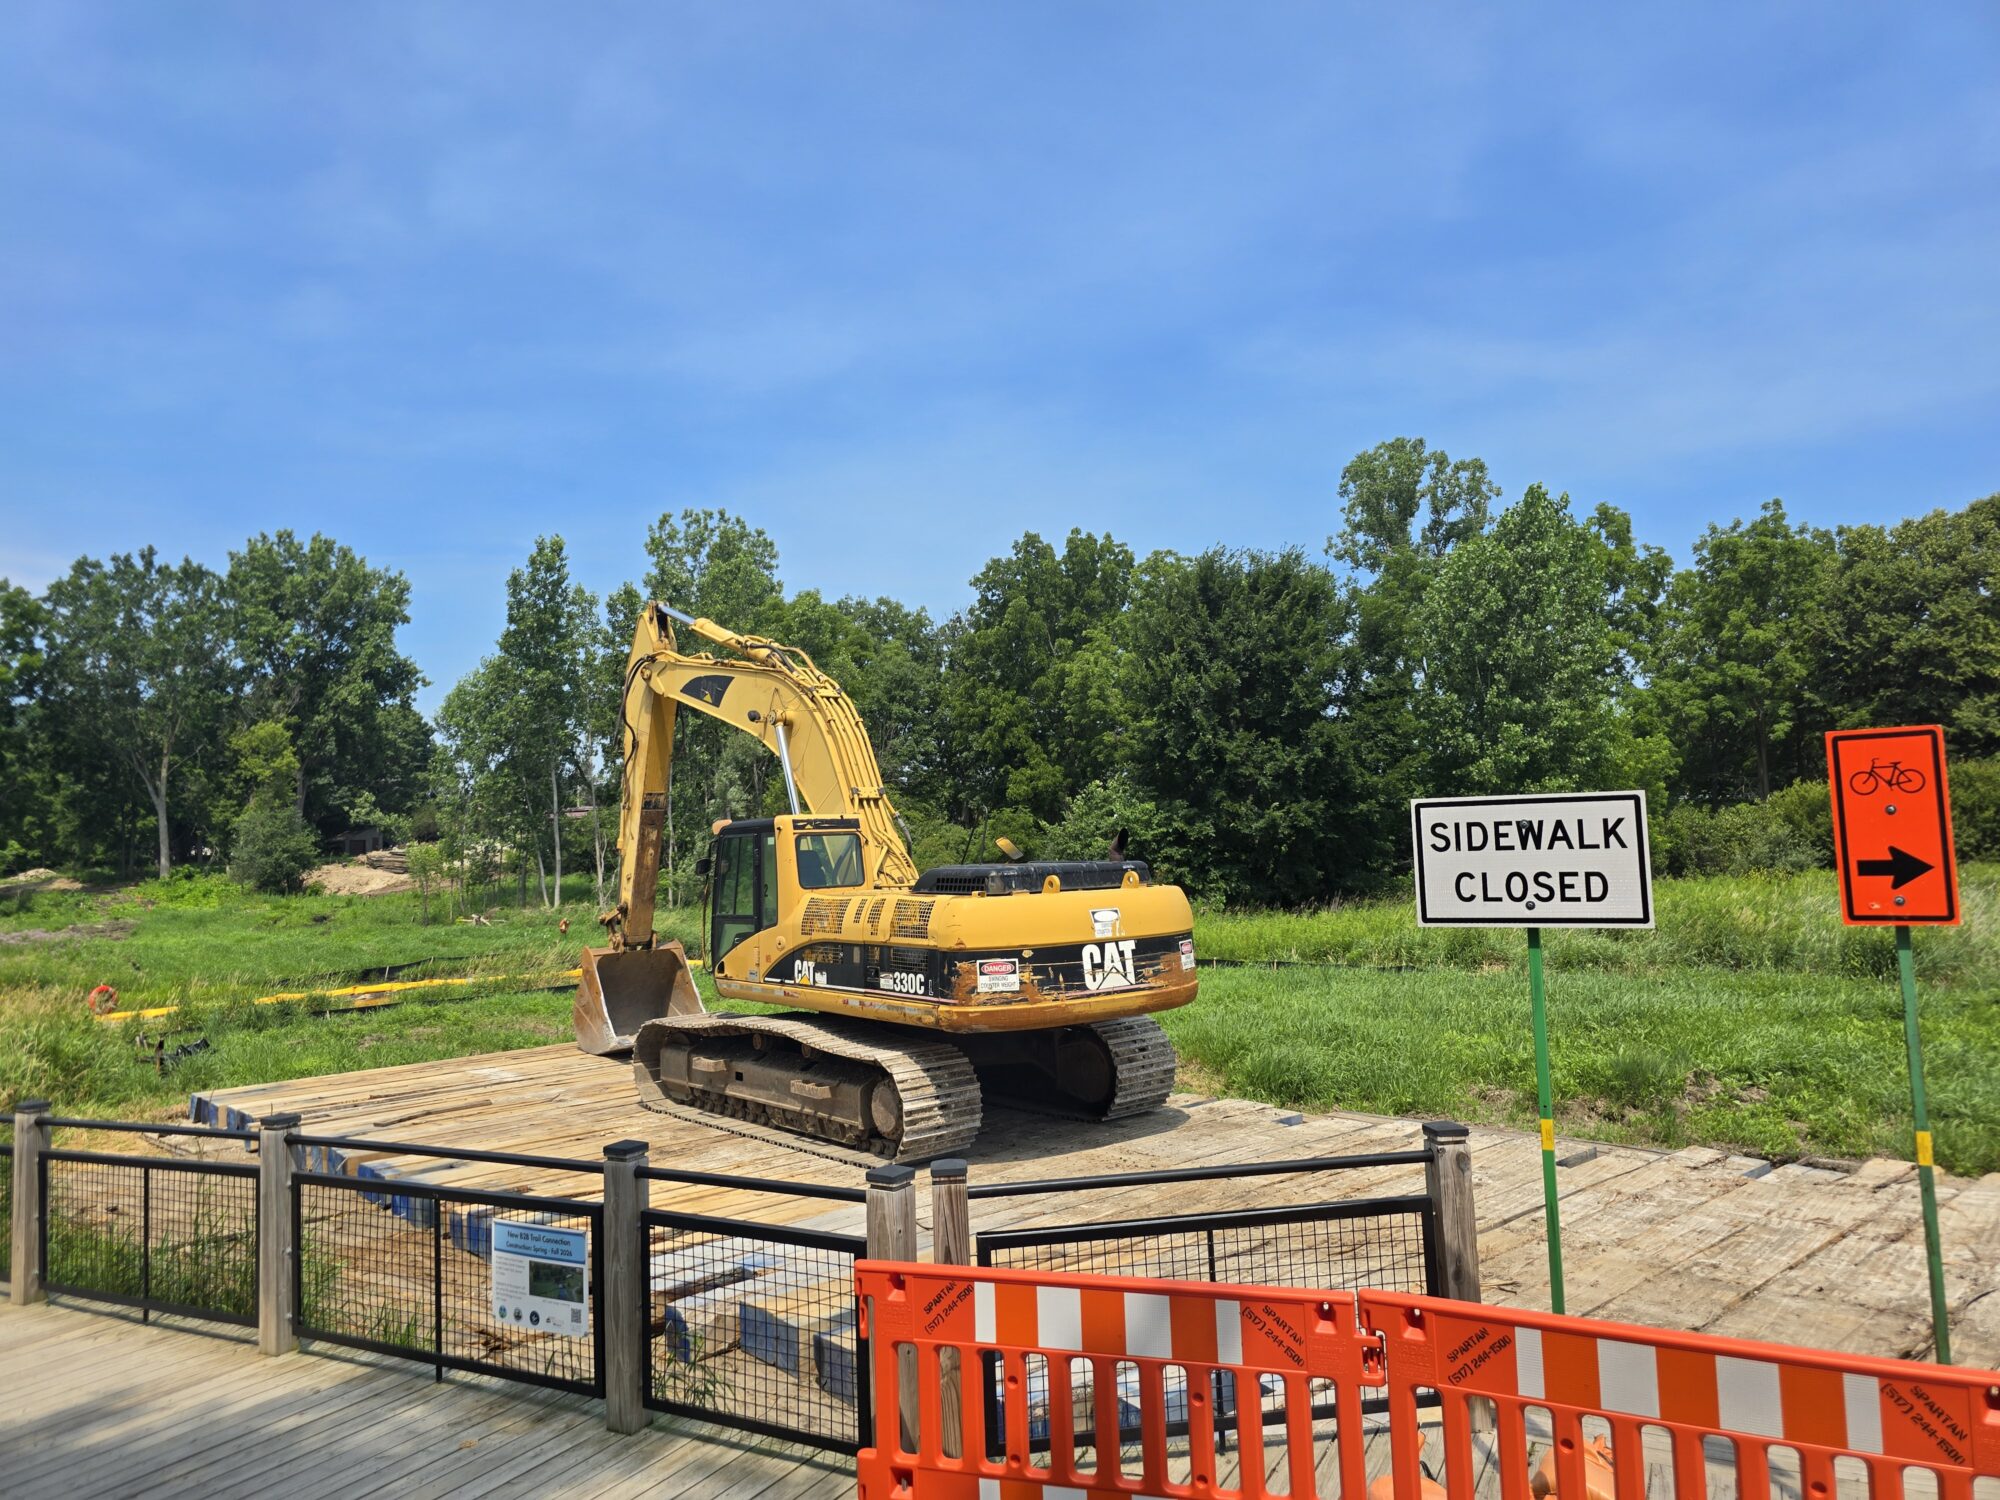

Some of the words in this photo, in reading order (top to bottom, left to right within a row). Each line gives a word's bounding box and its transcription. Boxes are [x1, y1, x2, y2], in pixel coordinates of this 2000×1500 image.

[1430, 817, 1628, 852] SIDEWALK
[1455, 871, 1609, 903] CLOSED
[794, 960, 816, 985] CAT
[1082, 940, 1136, 990] CAT
[894, 972, 924, 994] 330C
[507, 1230, 518, 1239] New
[520, 1232, 529, 1240] B2B
[530, 1234, 541, 1242] Trail
[542, 1236, 570, 1246] Connection
[532, 1245, 548, 1255] Spring
[924, 1280, 957, 1314] SPARTAN
[925, 1314, 944, 1334] (517)
[942, 1284, 974, 1317] 244-1500
[1240, 1306, 1266, 1331] (517)
[1264, 1328, 1304, 1367] 244-1500
[1262, 1305, 1304, 1346] SPARTAN
[1447, 1328, 1490, 1362] SPARTAN
[1448, 1364, 1473, 1386] (517)
[1471, 1334, 1512, 1369] 244-1500
[1880, 1384, 1914, 1414] (517)
[1910, 1413, 1965, 1464] 244-1500
[1910, 1386, 1968, 1441] SPARTAN
